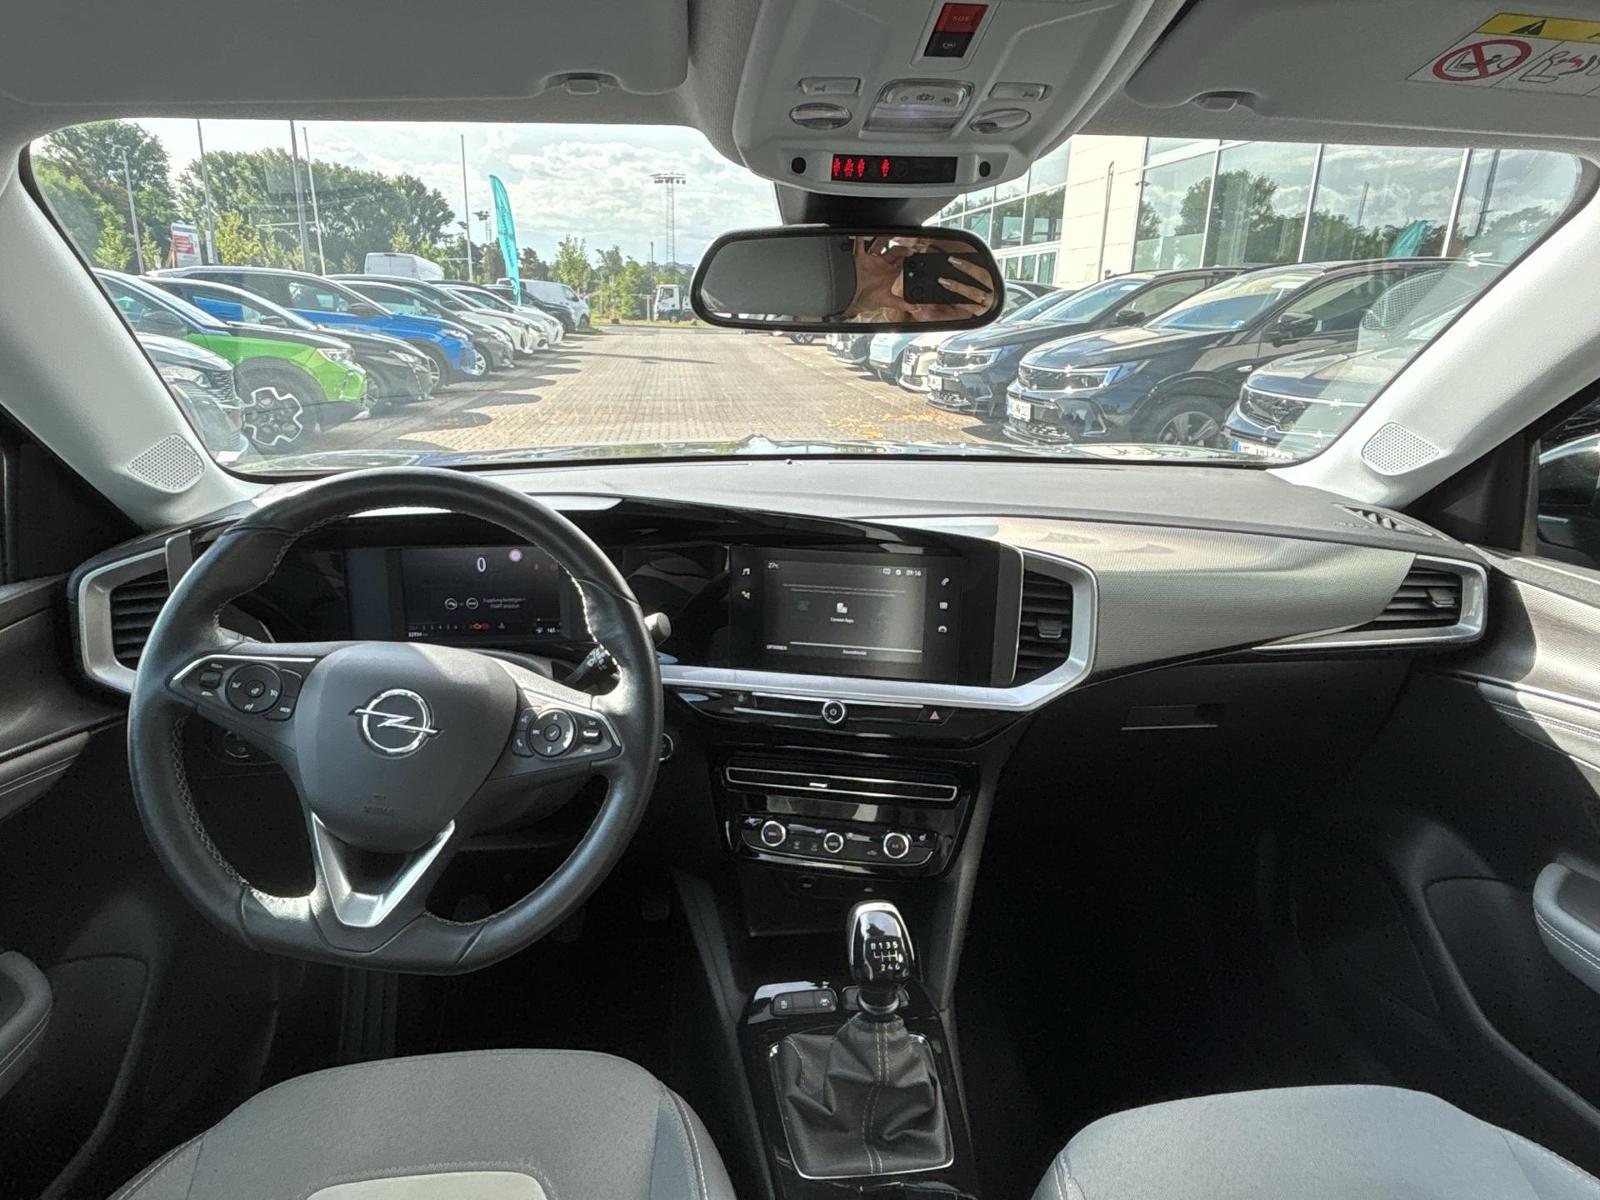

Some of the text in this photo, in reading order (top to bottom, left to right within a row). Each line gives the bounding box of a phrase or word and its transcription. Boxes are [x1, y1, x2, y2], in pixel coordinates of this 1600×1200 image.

[477, 557, 487, 573] 0
[885, 941, 891, 949] 3
[892, 940, 898, 949] 5
[880, 963, 886, 972] 2
